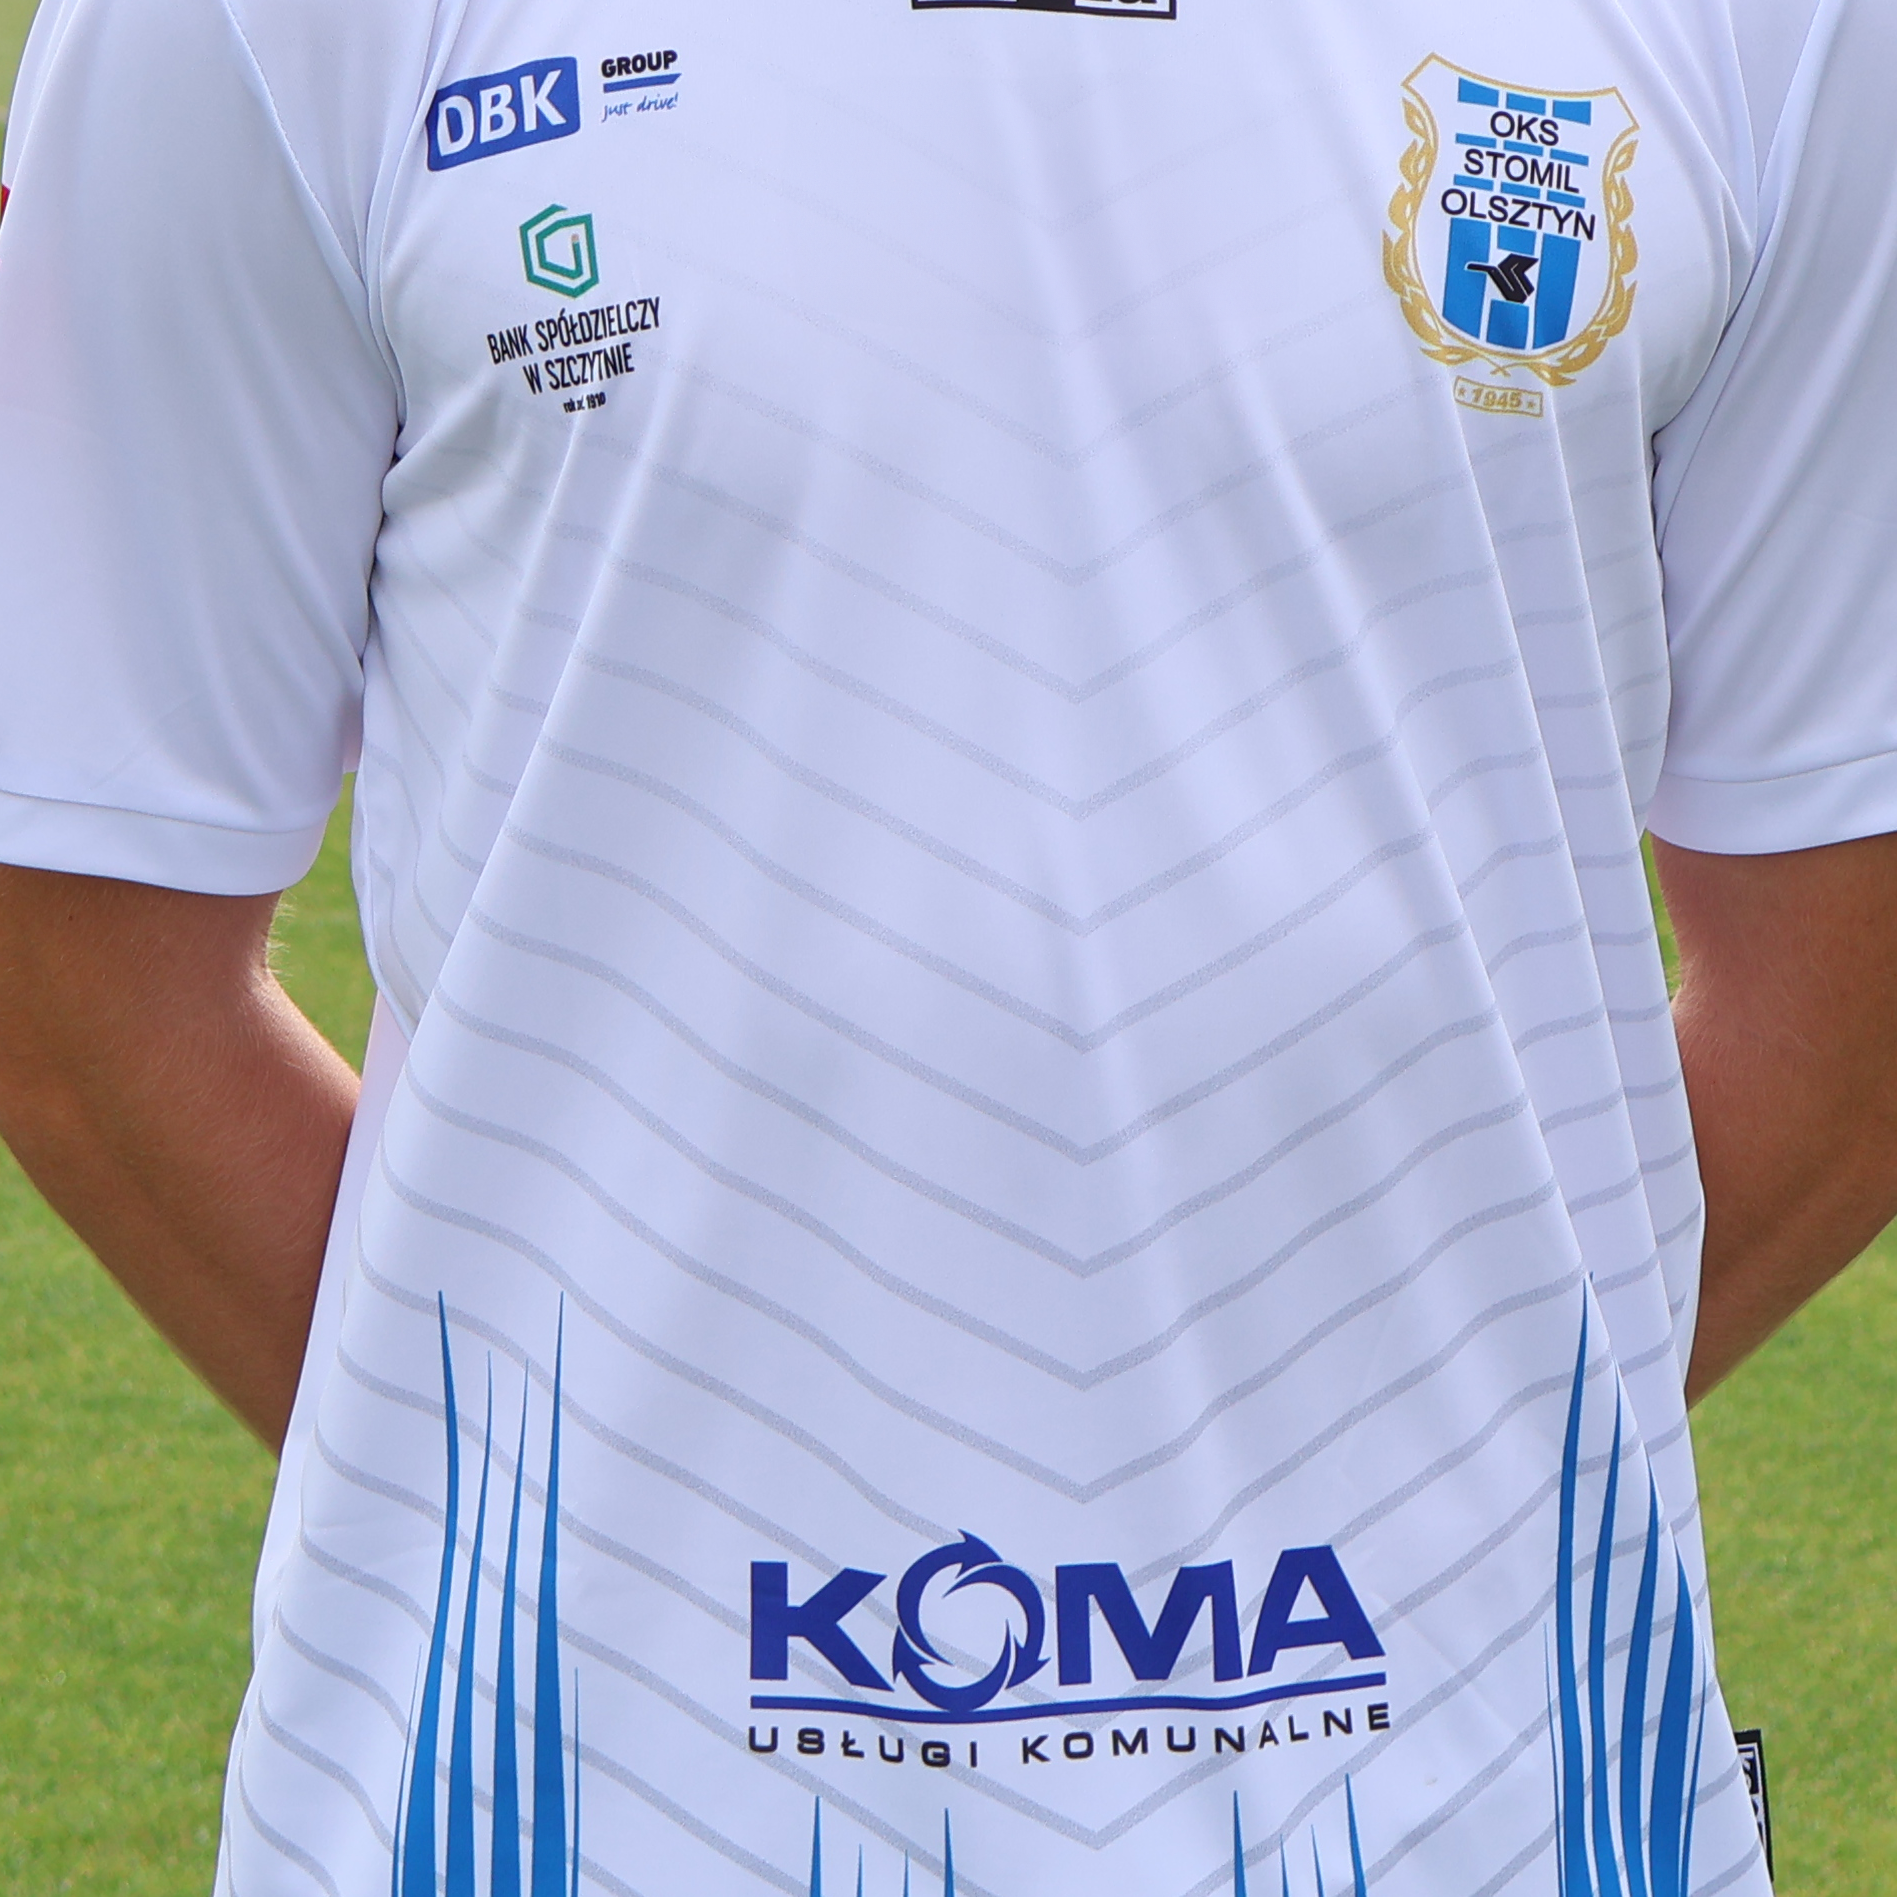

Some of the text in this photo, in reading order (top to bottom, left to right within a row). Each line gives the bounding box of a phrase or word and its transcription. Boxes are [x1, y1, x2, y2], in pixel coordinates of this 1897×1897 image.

[601, 50, 678, 78] GROUP
[437, 70, 567, 157] DBK
[601, 91, 678, 123] just drive!
[1490, 111, 1559, 147] OKS
[1463, 149, 1580, 194] STOMIL
[1440, 188, 1596, 241] OLSZTYN
[486, 297, 661, 365] BANK SPÓŁDZIELCZY
[523, 342, 635, 395] W SZCZYTNIE
[750, 1529, 1386, 1712] KOMA
[748, 1702, 1392, 1769] USŁUGI KOMUNALNE
